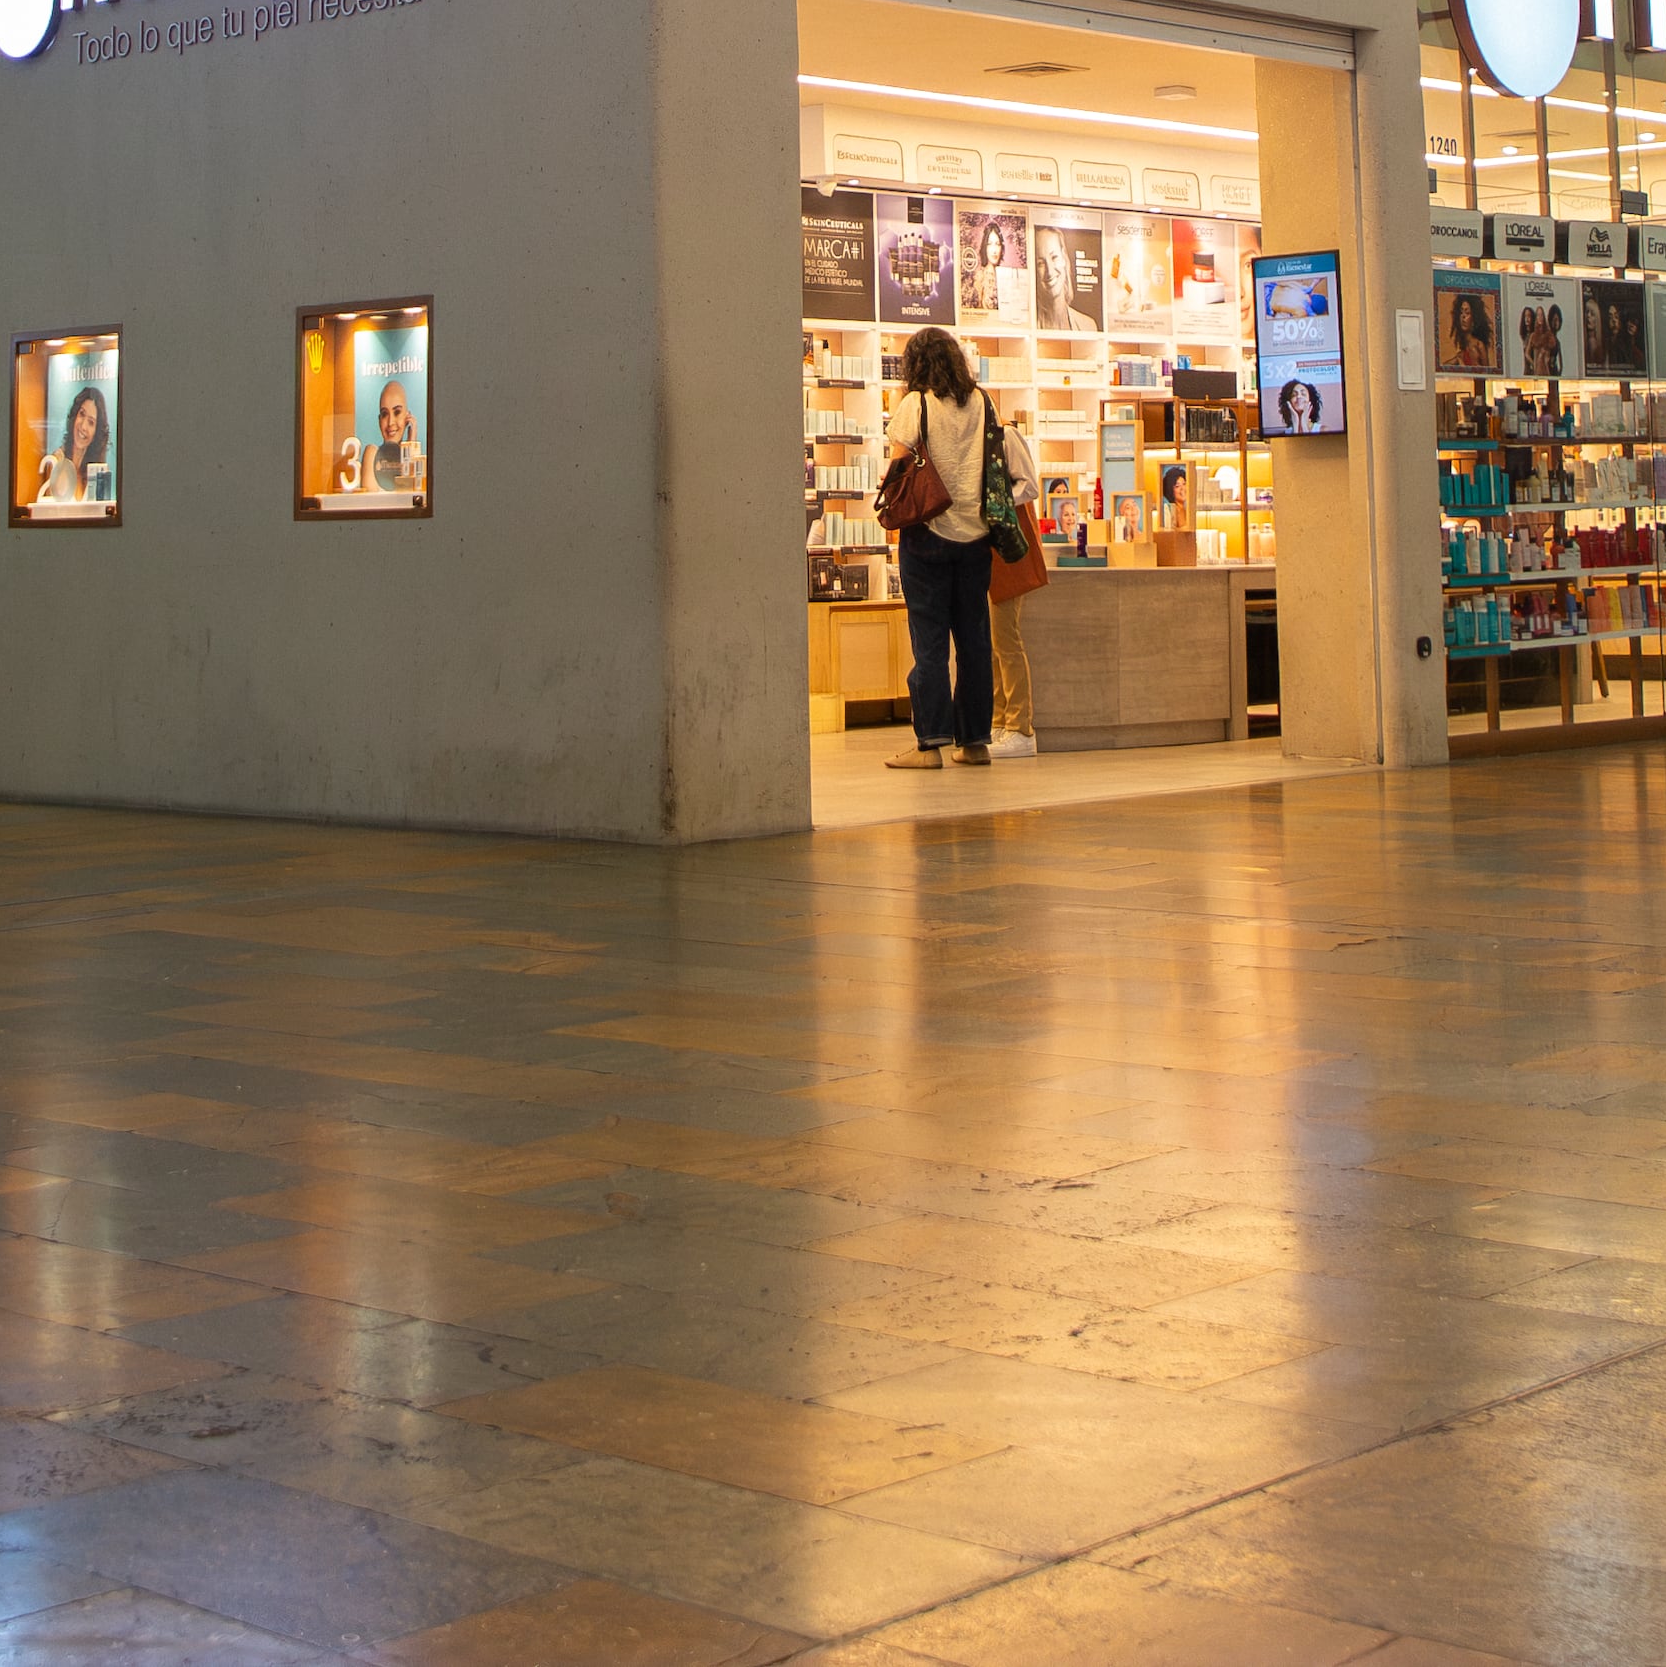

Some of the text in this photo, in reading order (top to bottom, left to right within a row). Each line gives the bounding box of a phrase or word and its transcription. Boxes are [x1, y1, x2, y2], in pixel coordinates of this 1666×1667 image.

[73, 26, 131, 64] Todo
[139, 20, 158, 53] lo
[166, 15, 214, 55] que
[221, 9, 245, 37] tu
[1429, 135, 1458, 157] 1240
[1430, 224, 1479, 239] OROCCANOIL
[1586, 243, 1612, 253] WELLA
[1272, 319, 1318, 341] 50%
[360, 355, 425, 377] Irrepetible
[1264, 359, 1297, 379] 3x2
[339, 436, 362, 491] 3
[37, 454, 58, 503] 2
